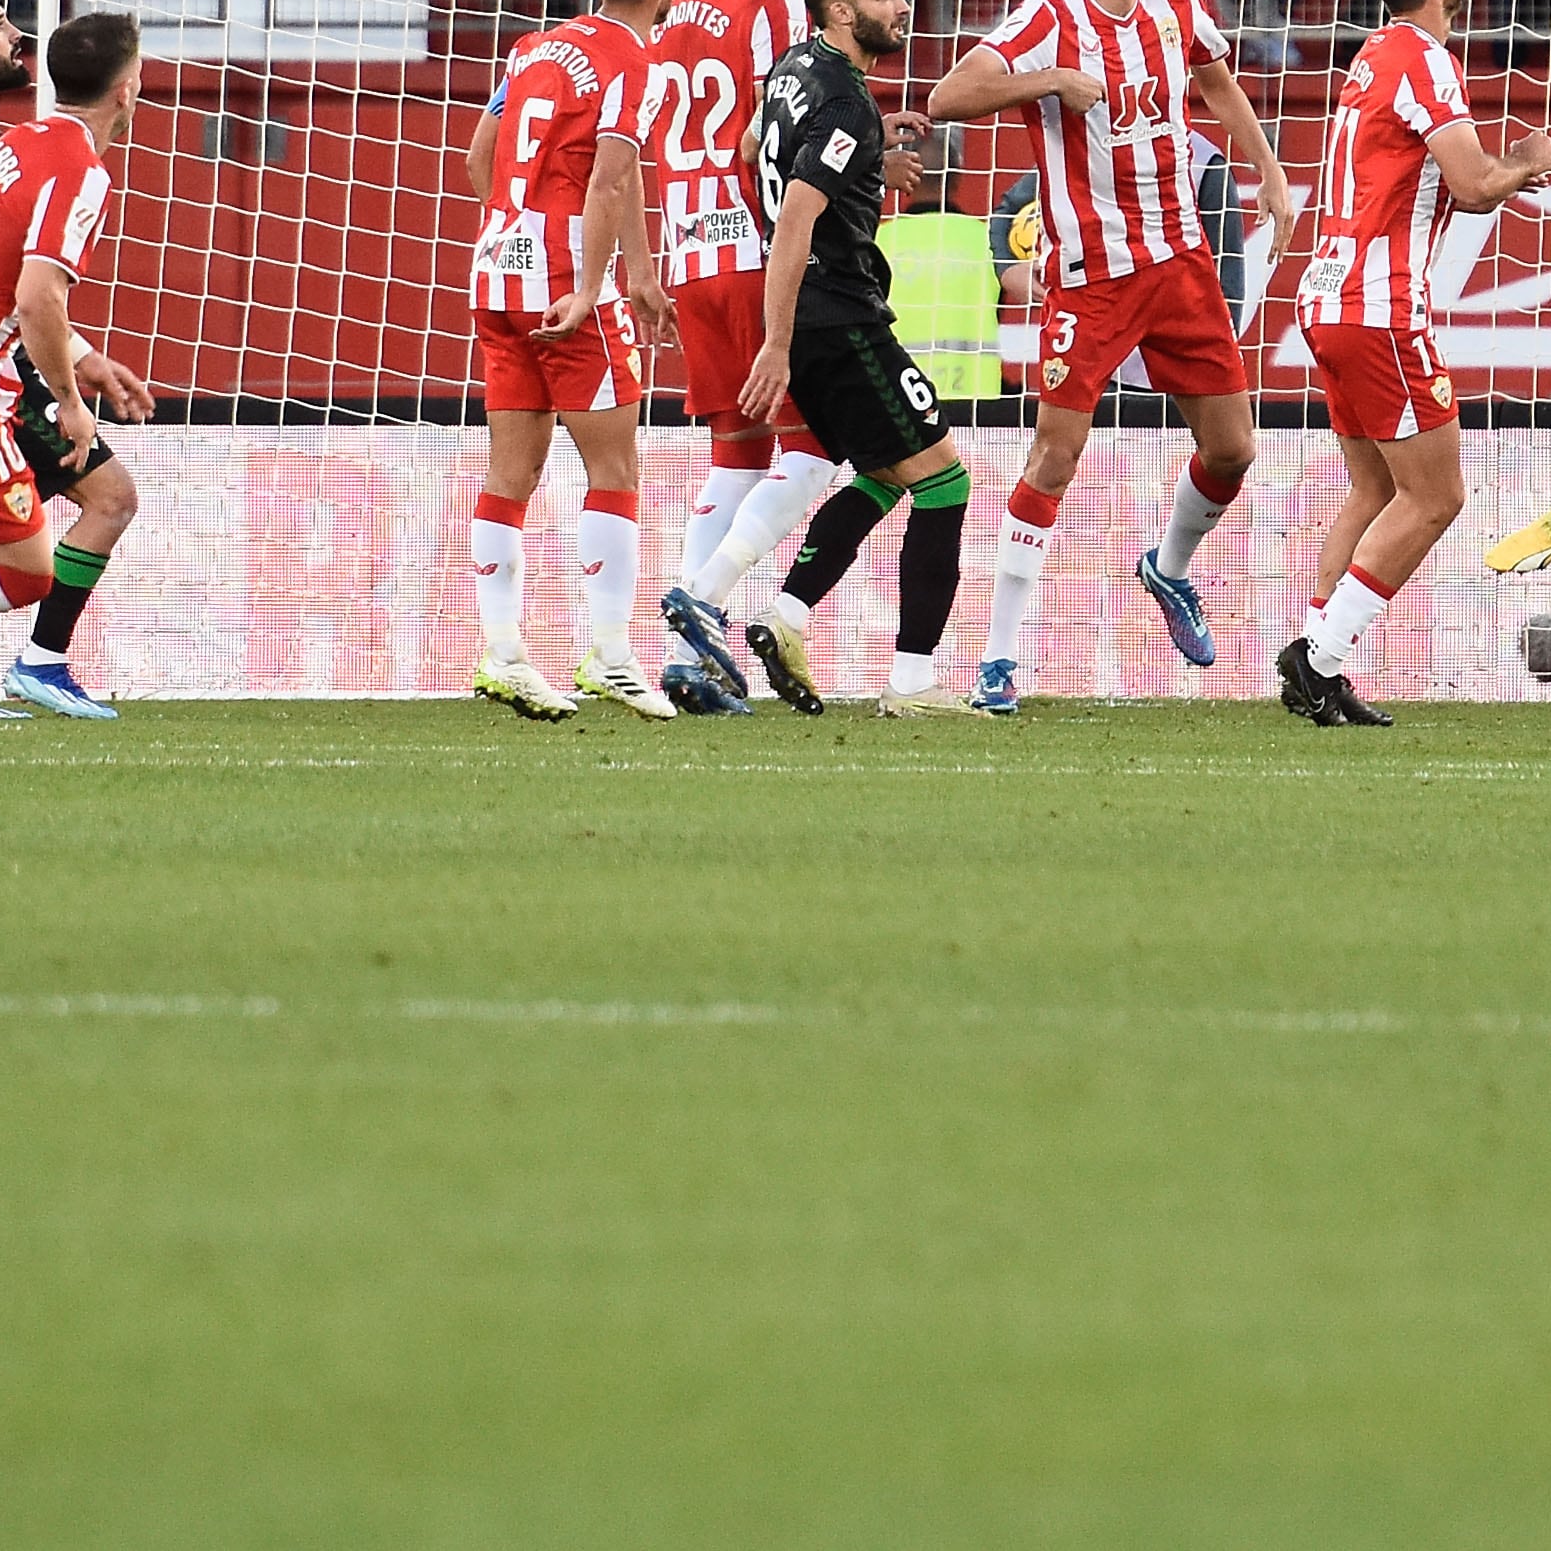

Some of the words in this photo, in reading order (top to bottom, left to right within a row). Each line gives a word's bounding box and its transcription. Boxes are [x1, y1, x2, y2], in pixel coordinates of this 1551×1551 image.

[663, 57, 737, 172] 22
[1112, 75, 1162, 132] JK
[1325, 105, 1361, 220] 11
[703, 209, 749, 227] POWER
[707, 224, 750, 244] HORSE
[613, 298, 636, 346] 5
[1052, 310, 1079, 354] 3
[900, 366, 935, 412] 6
